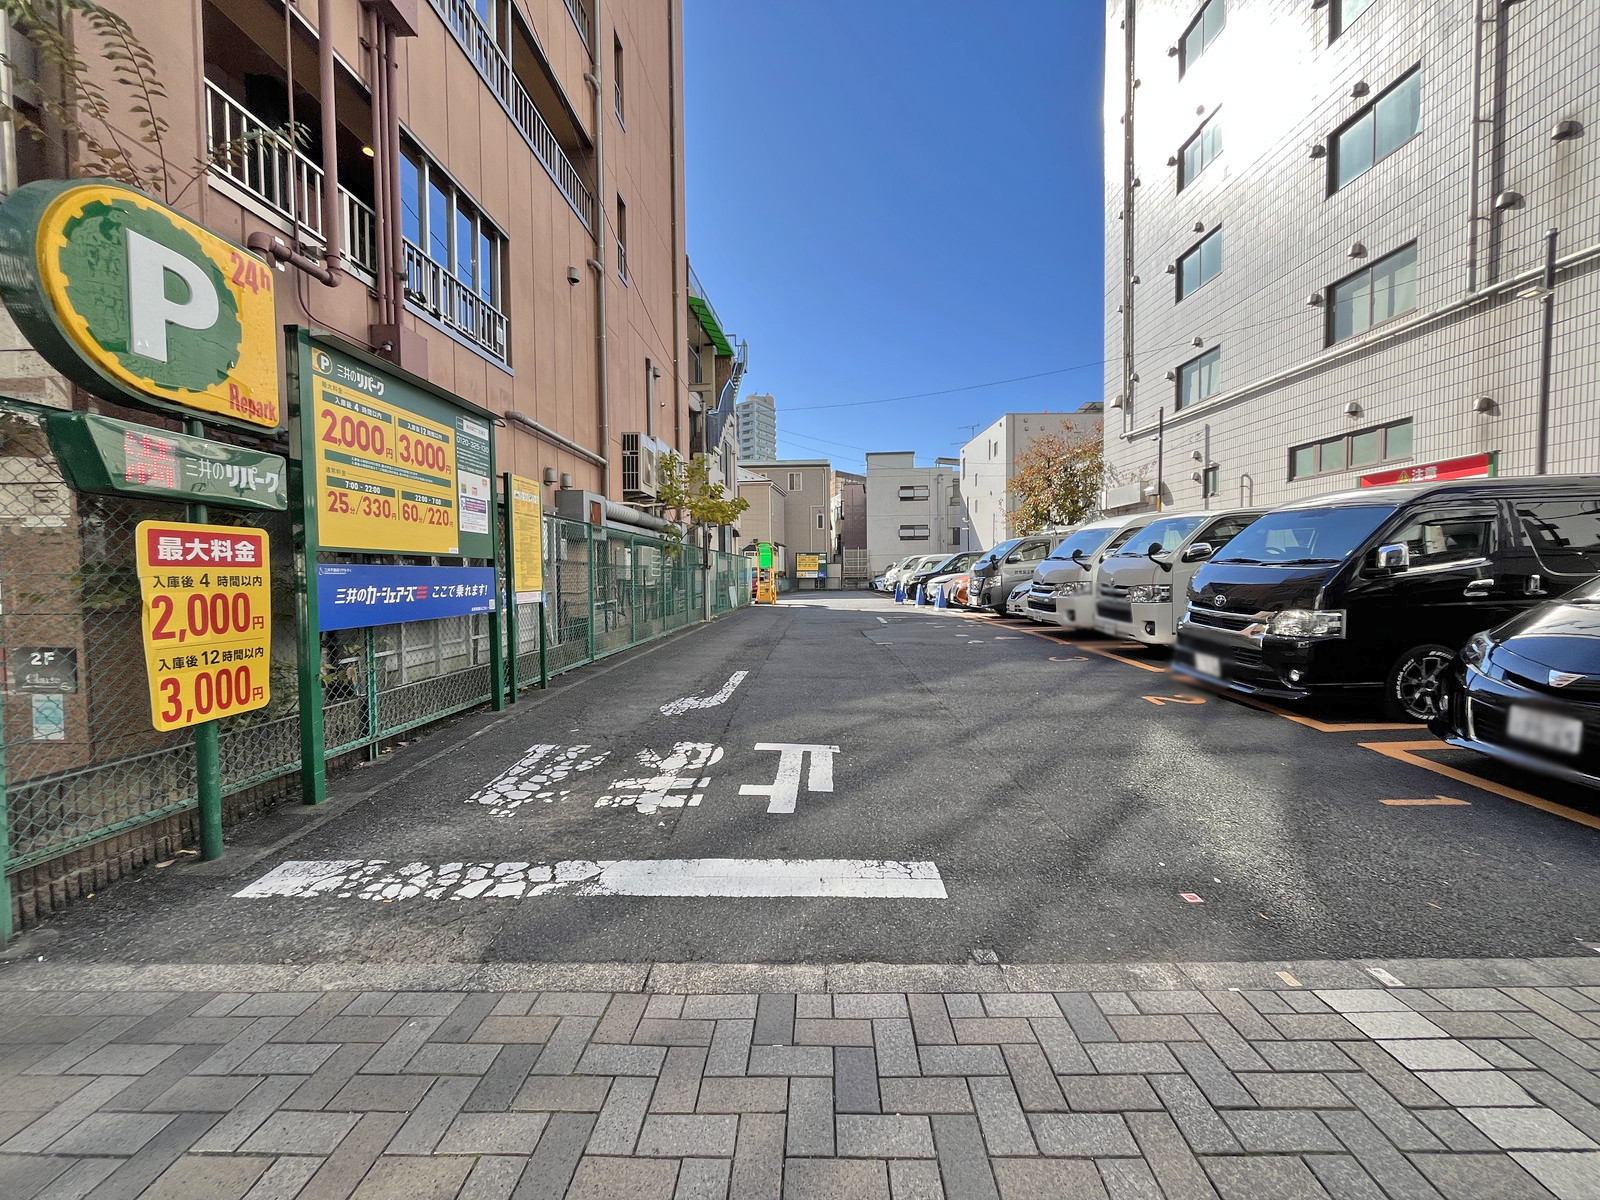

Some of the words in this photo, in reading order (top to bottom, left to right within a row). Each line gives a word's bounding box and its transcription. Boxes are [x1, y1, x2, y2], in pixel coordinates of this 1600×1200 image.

[230, 251, 271, 294] 24h
[126, 228, 219, 363] P
[320, 355, 330, 370] P
[337, 364, 385, 396] 三井のリパーク
[229, 383, 277, 422] Repark
[321, 408, 393, 460] 2,000円
[398, 433, 452, 475] 3,000円
[185, 457, 279, 492] 三井のリパーク
[344, 480, 359, 491] 7:00
[157, 536, 256, 563] 最大料金
[152, 575, 195, 589] 入庫後
[199, 573, 211, 588] 4
[216, 575, 263, 588] 時間以内
[334, 585, 418, 605] 三井のカーシェアーズ
[431, 583, 488, 598] ここで乗れます!
[151, 592, 265, 643] 2,000円
[30, 651, 55, 666] 2F
[160, 665, 264, 723] 3,000円
[1141, 693, 1207, 706] 2
[1378, 794, 1472, 806] 1
